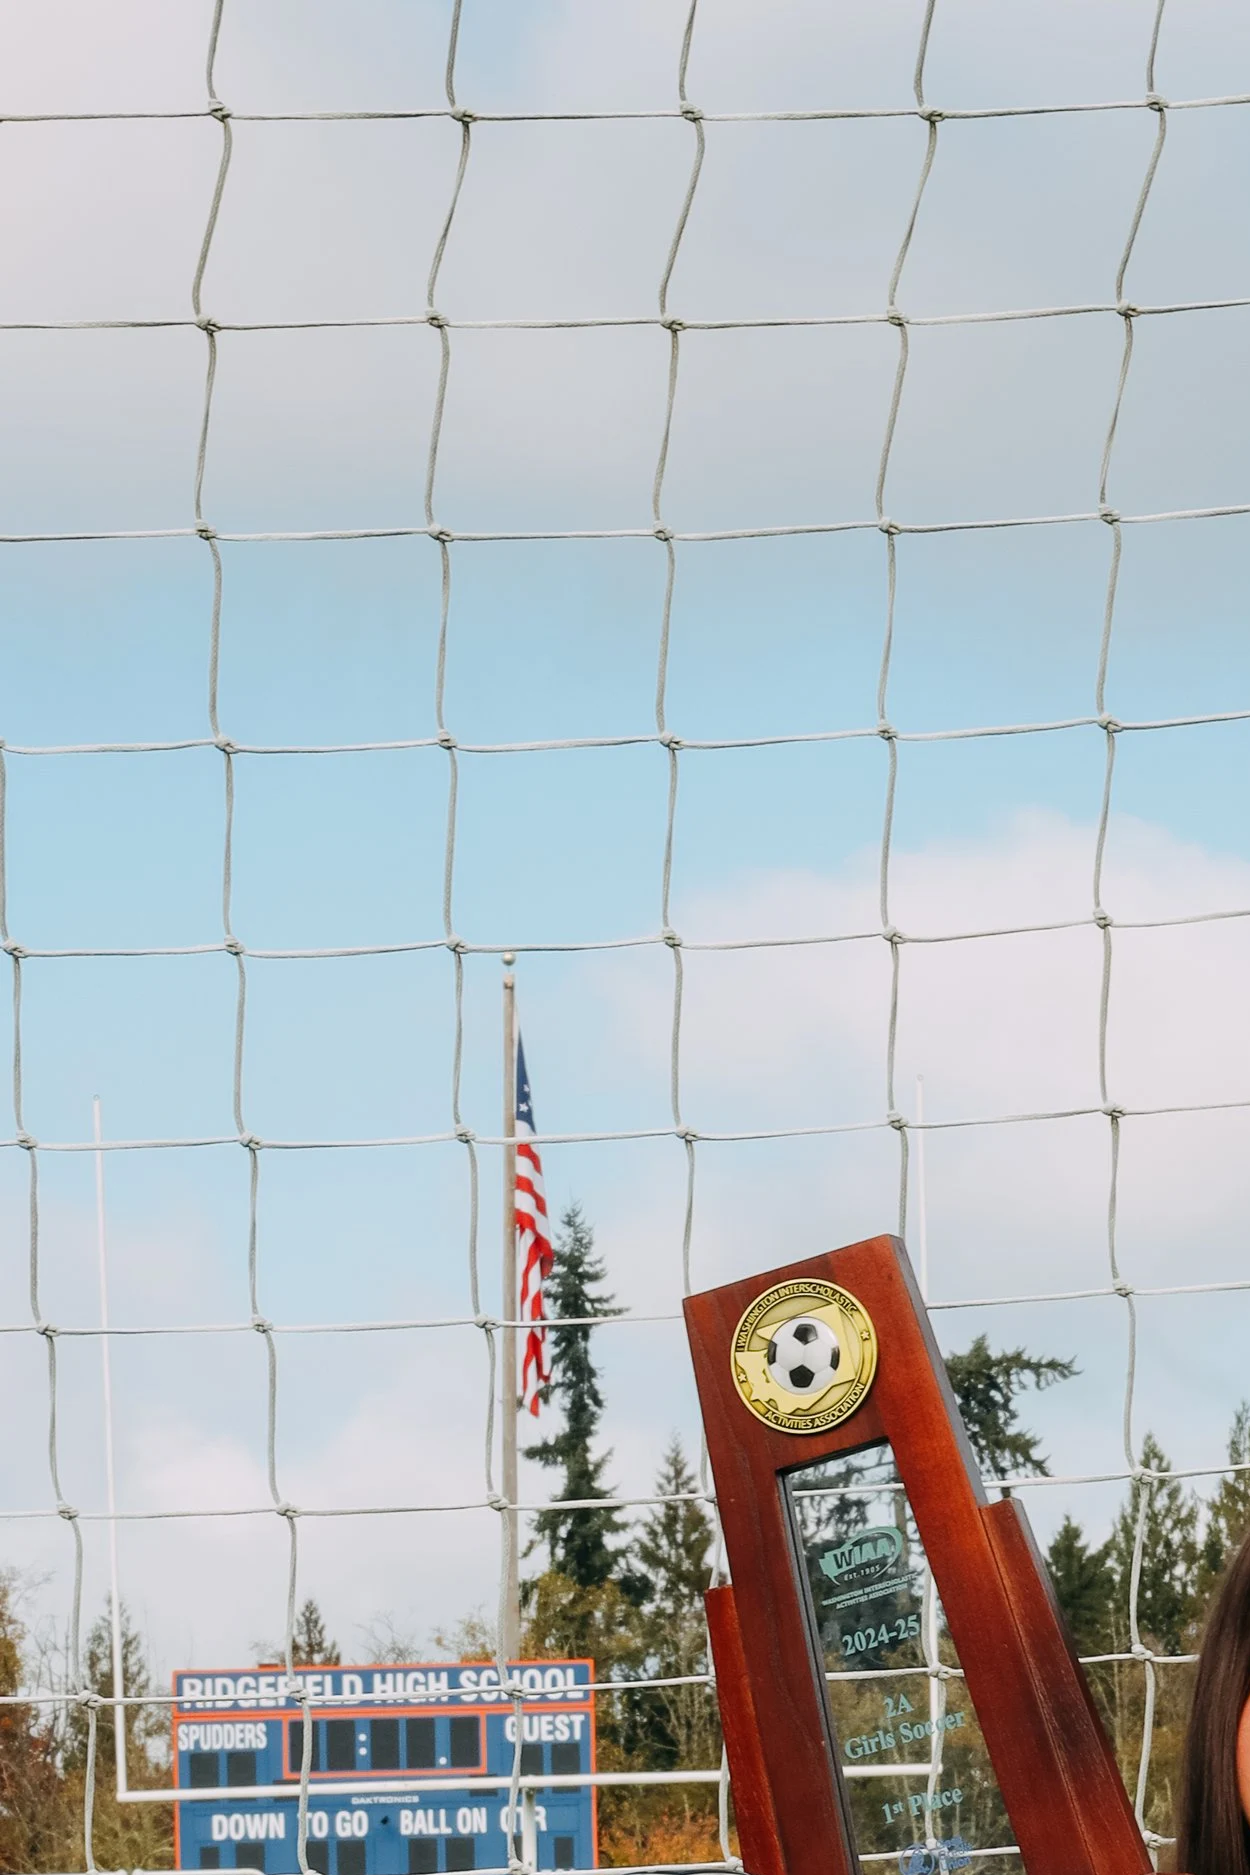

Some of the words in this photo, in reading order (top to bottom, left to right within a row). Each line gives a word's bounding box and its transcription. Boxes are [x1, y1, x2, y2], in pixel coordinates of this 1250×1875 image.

[736, 1290, 779, 1352] WASHINGTON
[778, 1283, 858, 1316] INTERSCHOLASTIC
[765, 1409, 813, 1430] ACTIVITIES
[813, 1382, 865, 1428] ASSOCIATION
[832, 1537, 892, 1569] WIAA
[842, 1614, 921, 1656] 2024-25
[373, 1671, 449, 1704] HIGH
[883, 1693, 914, 1719] 2A
[178, 1723, 268, 1751] SPUDDERS
[504, 1714, 585, 1742] GUEST
[844, 1730, 897, 1760] Girls
[900, 1711, 965, 1744] Soccer
[351, 1795, 420, 1805] DAKTRONICS
[909, 1787, 964, 1817] Place
[212, 1812, 285, 1841] DOWN
[335, 1810, 369, 1838] GO
[400, 1808, 453, 1836] BALL
[457, 1807, 487, 1834] ON
